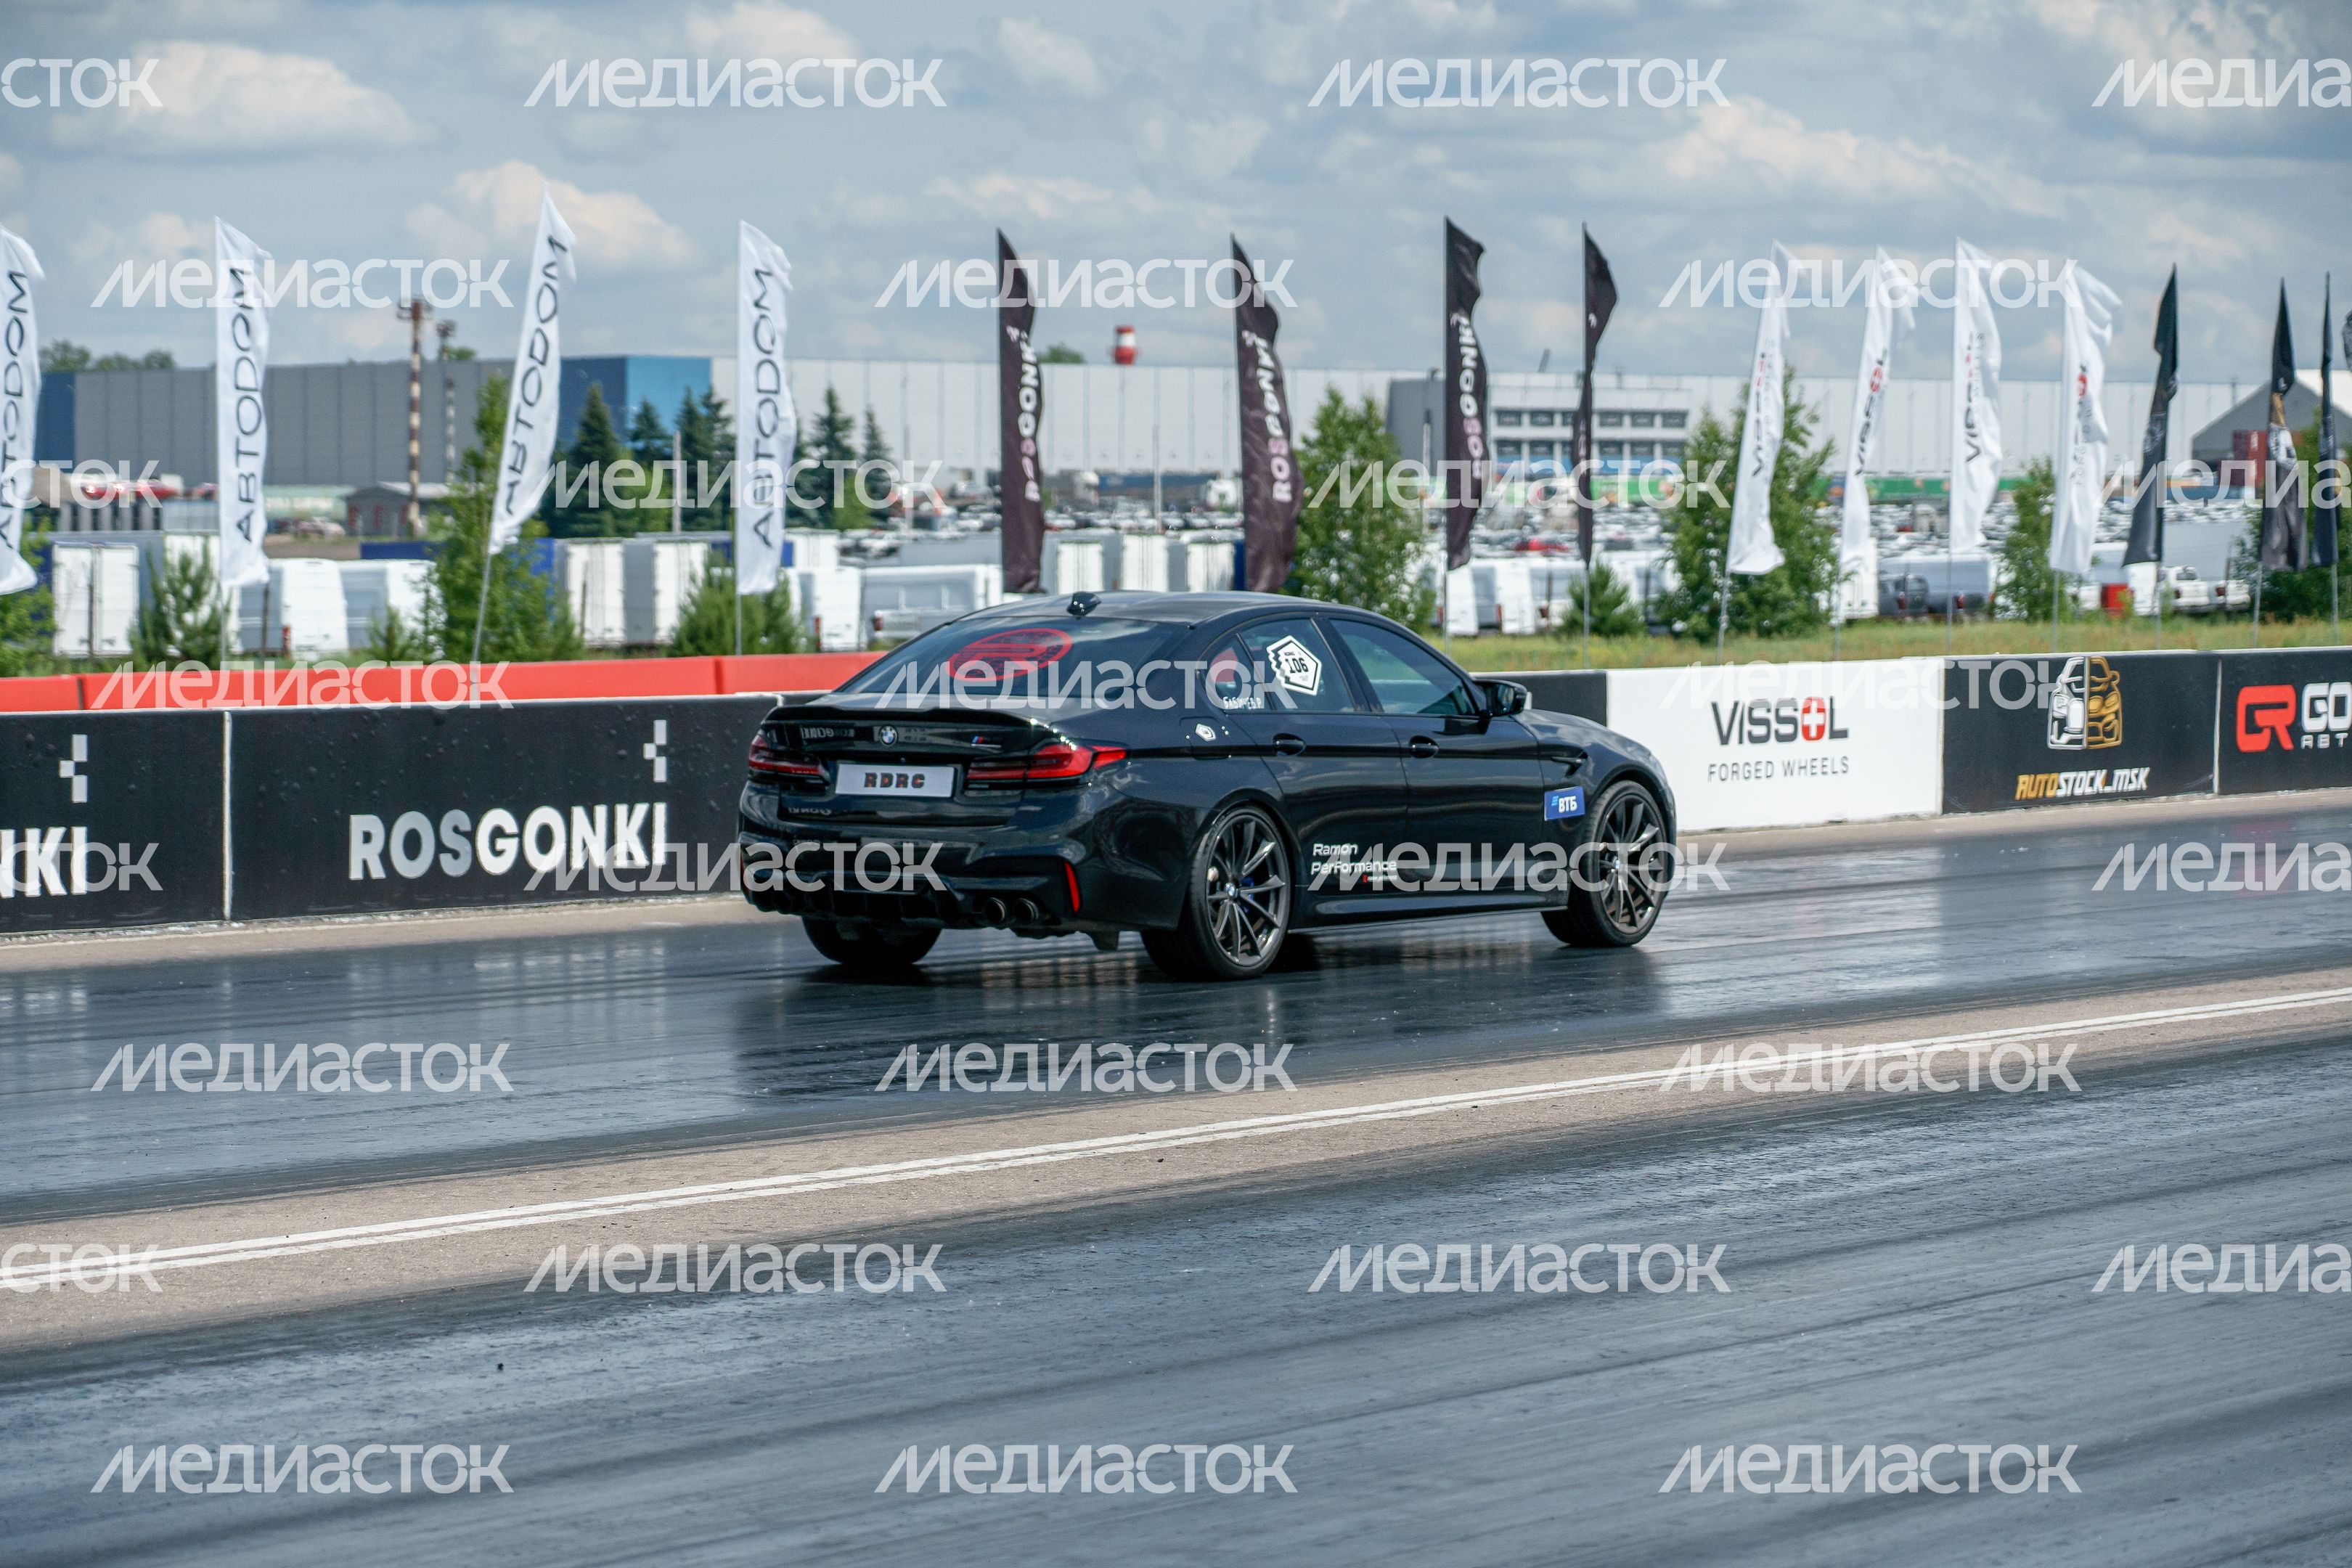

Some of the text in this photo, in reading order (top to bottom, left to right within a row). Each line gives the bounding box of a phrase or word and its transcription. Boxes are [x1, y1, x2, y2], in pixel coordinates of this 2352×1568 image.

[1285, 656, 1309, 674] 106
[1710, 695, 1849, 746] VISSOL
[1707, 756, 1849, 783] FORGED WHEELS
[864, 772, 926, 789] RDRC
[1558, 795, 1578, 813] ВТБ
[349, 801, 667, 881] ROSGONKI
[1312, 843, 1359, 857] Ramon
[1310, 859, 1397, 875] Performance
